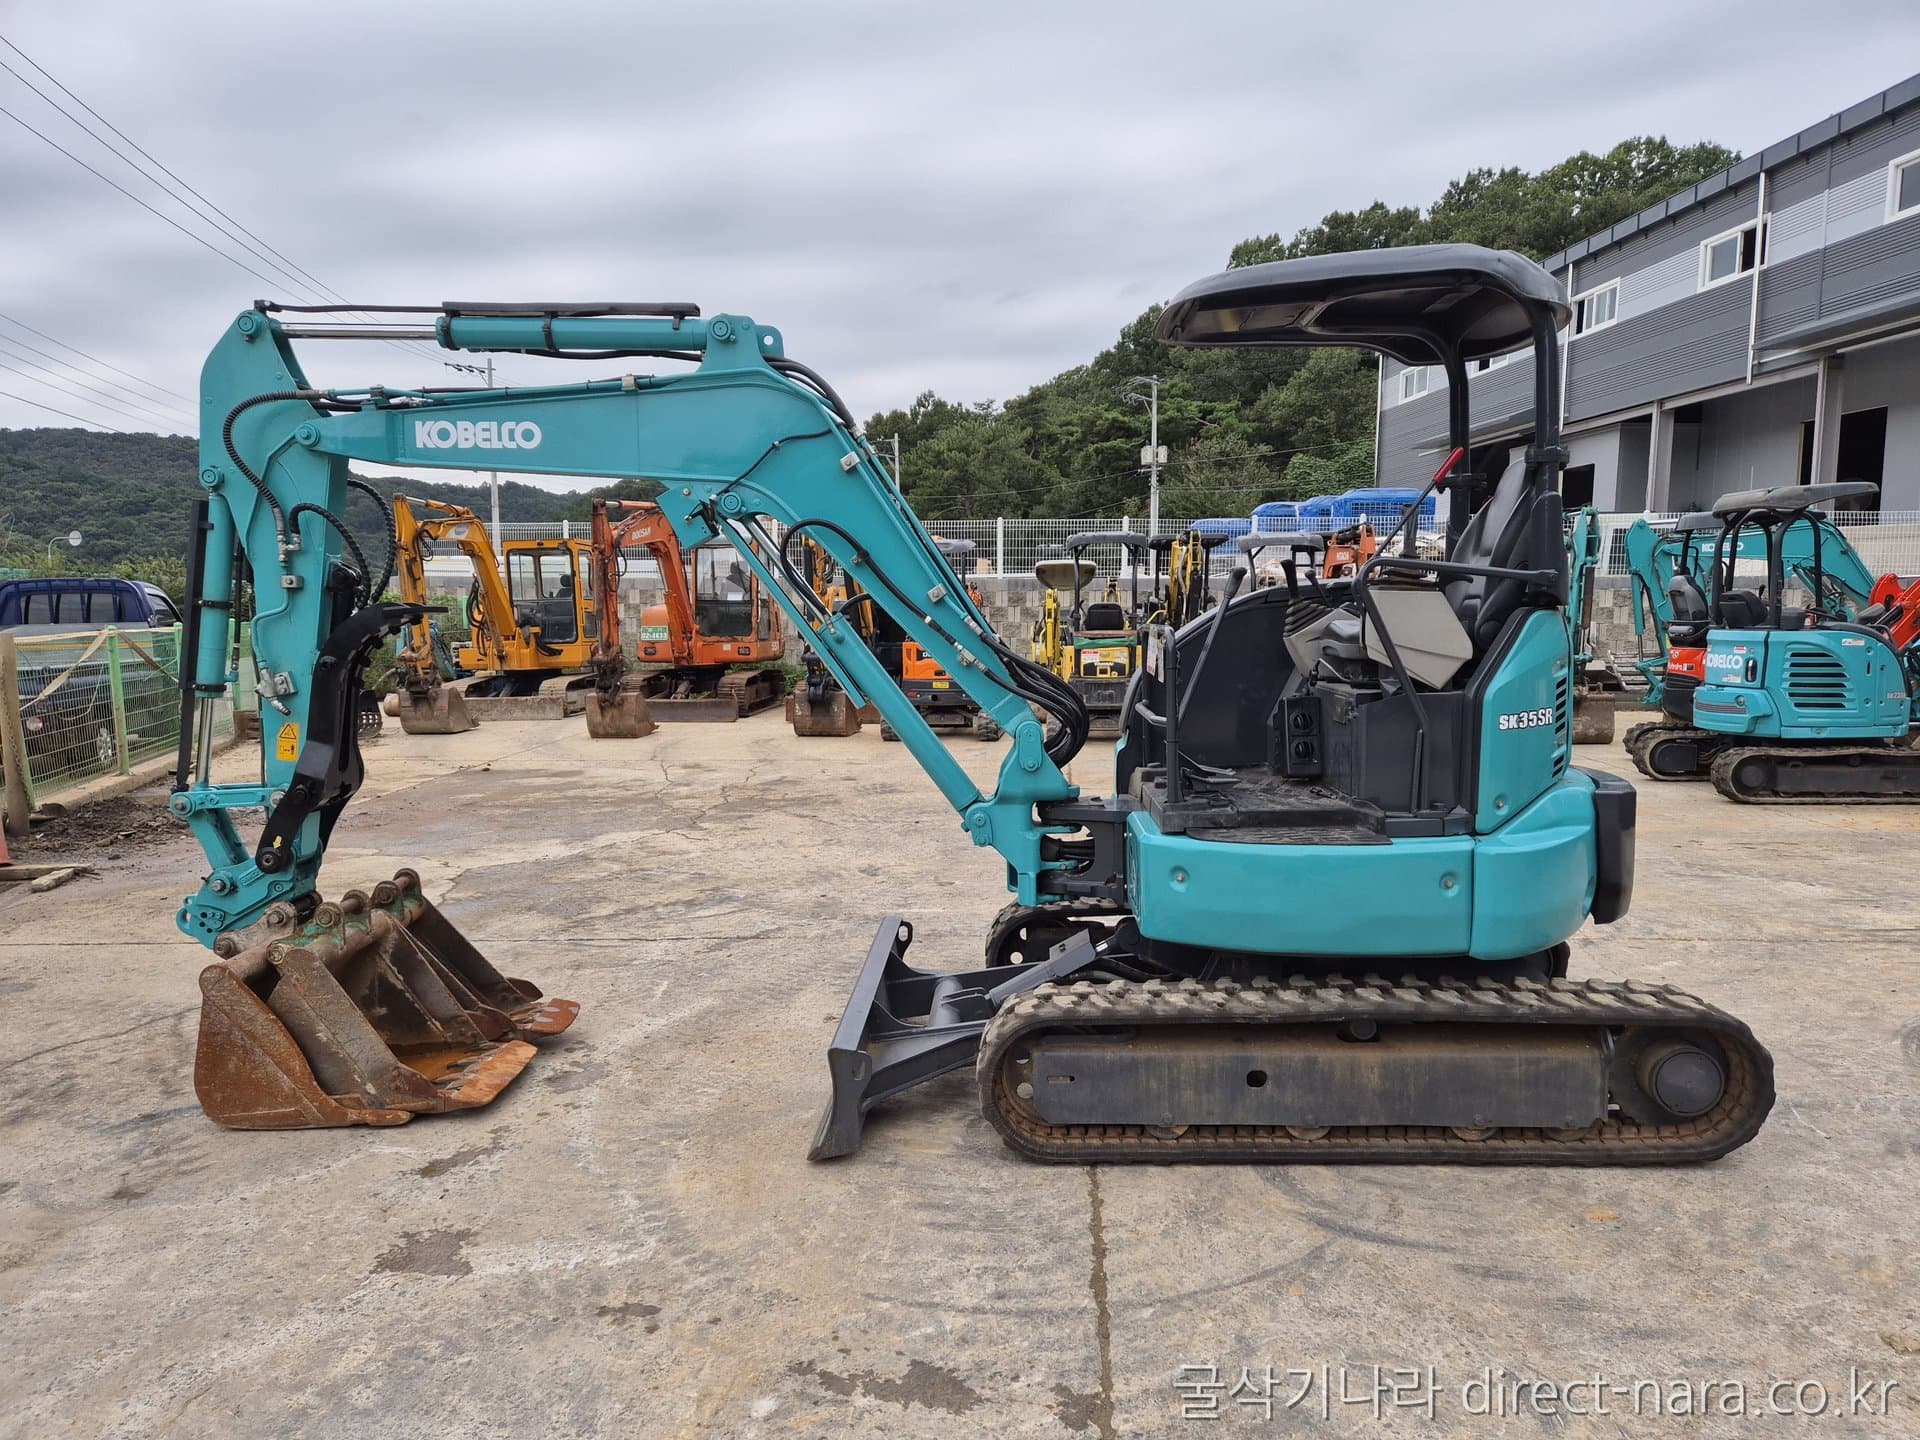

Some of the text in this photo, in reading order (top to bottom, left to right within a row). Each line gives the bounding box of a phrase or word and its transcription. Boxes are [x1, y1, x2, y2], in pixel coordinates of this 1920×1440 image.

[415, 420, 542, 449] KOBELCO
[1702, 542, 1744, 552] KOELO
[1499, 707, 1553, 730] SK35SR
